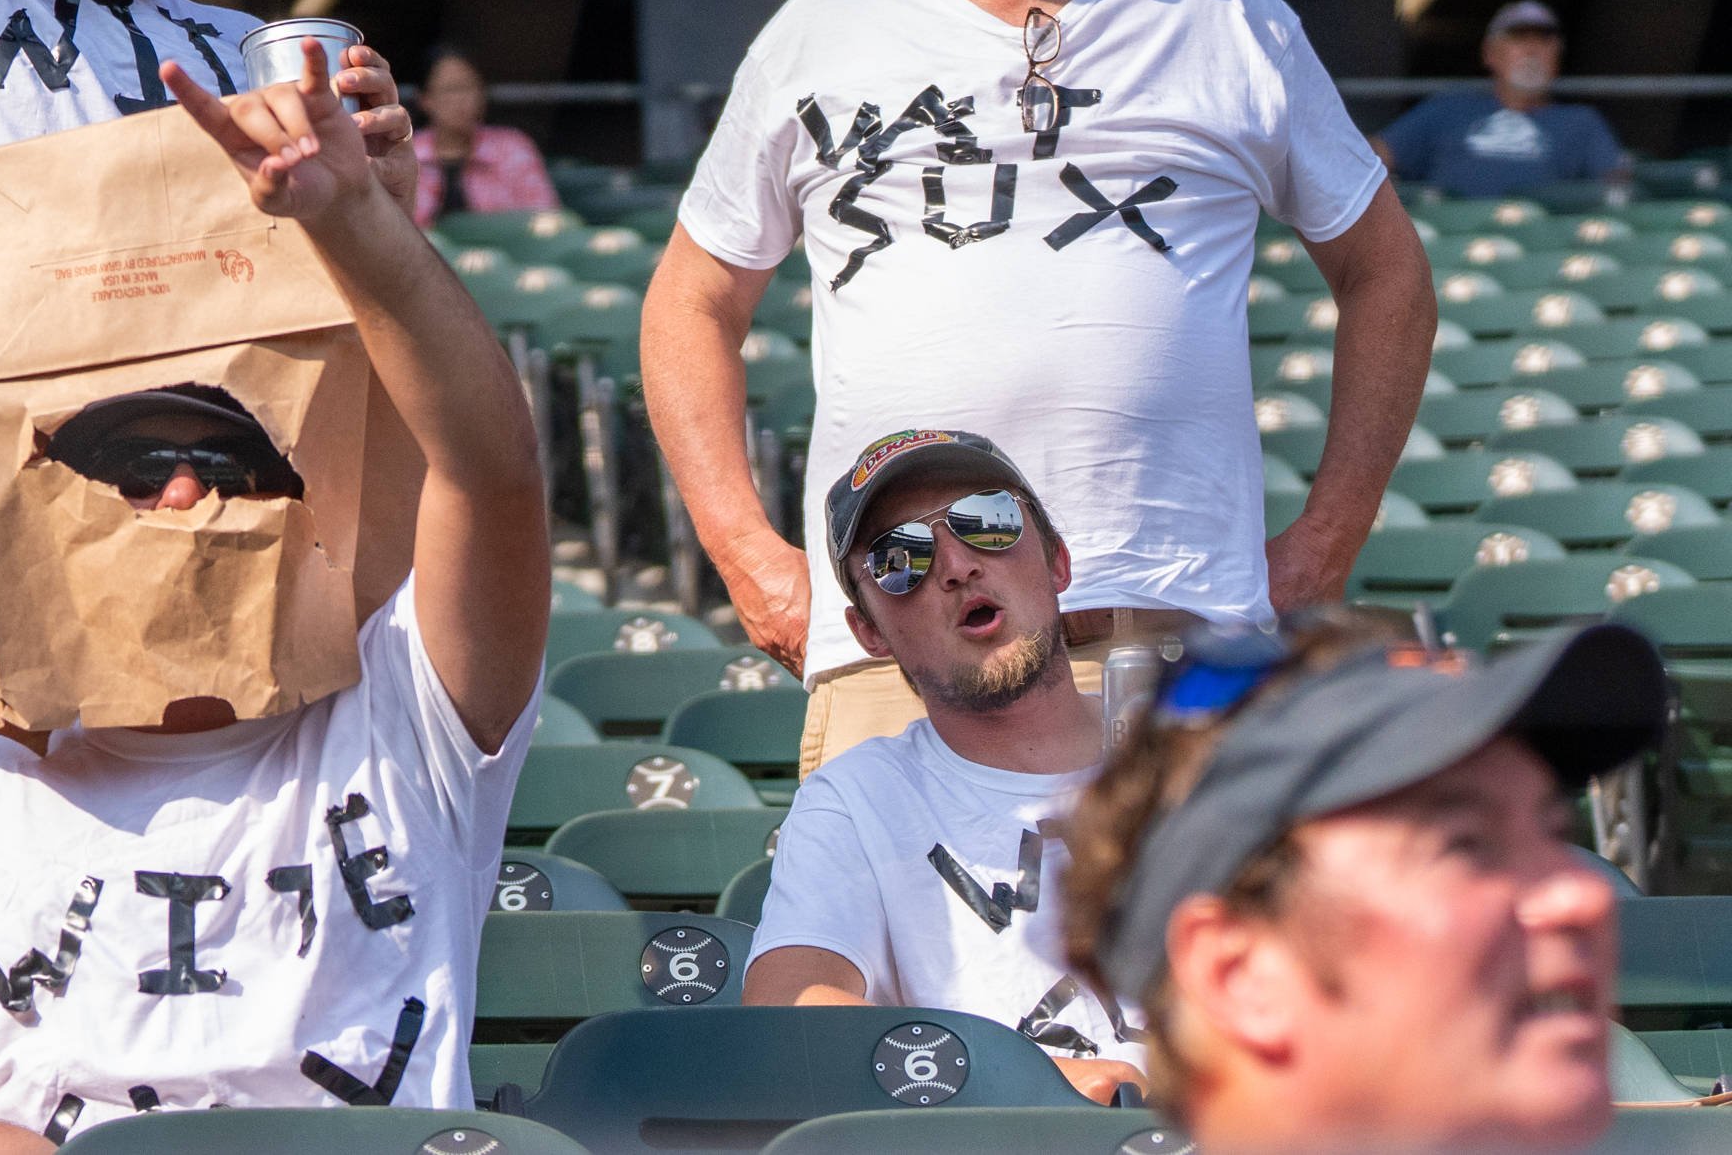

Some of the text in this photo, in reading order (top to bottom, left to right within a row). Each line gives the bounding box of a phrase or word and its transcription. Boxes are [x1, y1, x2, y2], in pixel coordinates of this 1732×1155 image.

[829, 160, 1179, 294] SUX
[101, 275, 119, 287] USA
[645, 773, 676, 799] 7
[498, 885, 528, 912] 6
[669, 952, 700, 982] 6
[903, 1049, 939, 1082] 6
